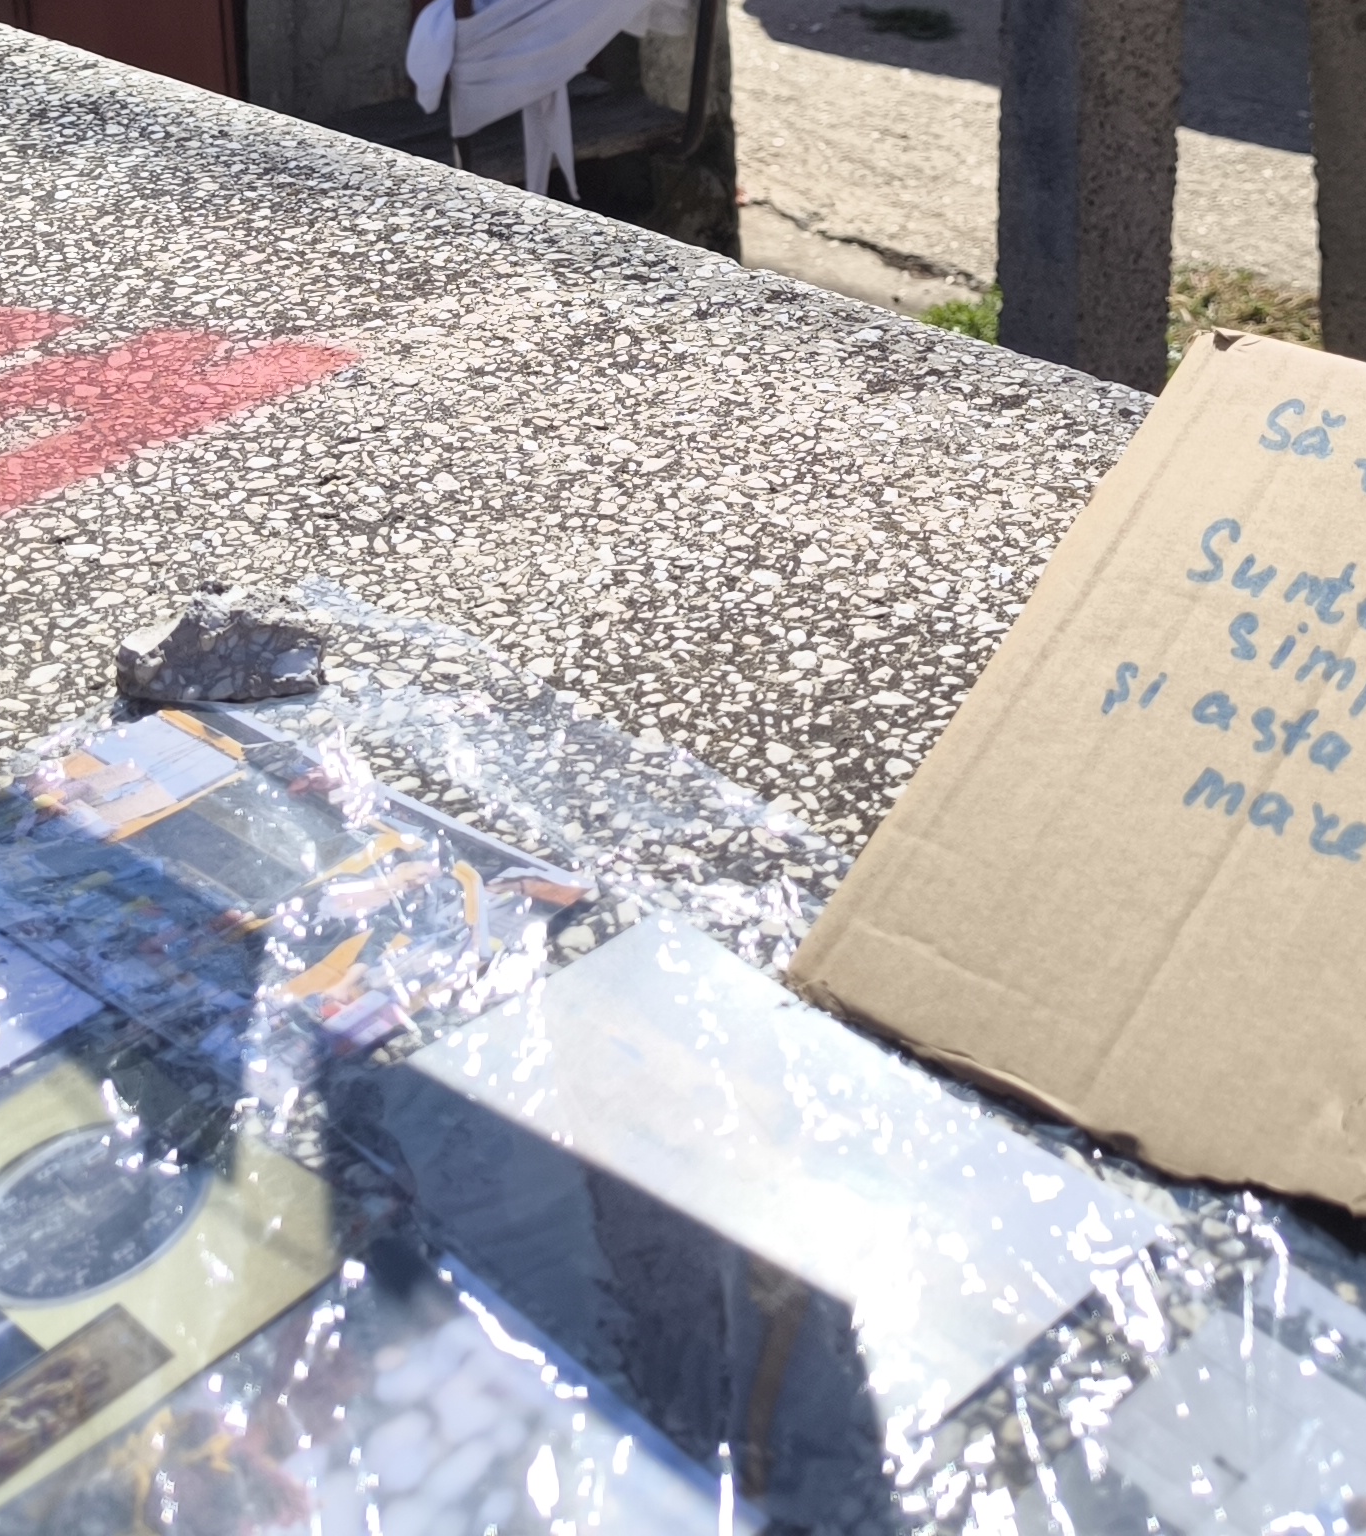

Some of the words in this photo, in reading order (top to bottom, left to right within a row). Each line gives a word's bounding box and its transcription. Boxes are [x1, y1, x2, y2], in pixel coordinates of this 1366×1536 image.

[1259, 398, 1346, 460] Să
[1102, 662, 1168, 715] și
[1192, 691, 1352, 773] asta
